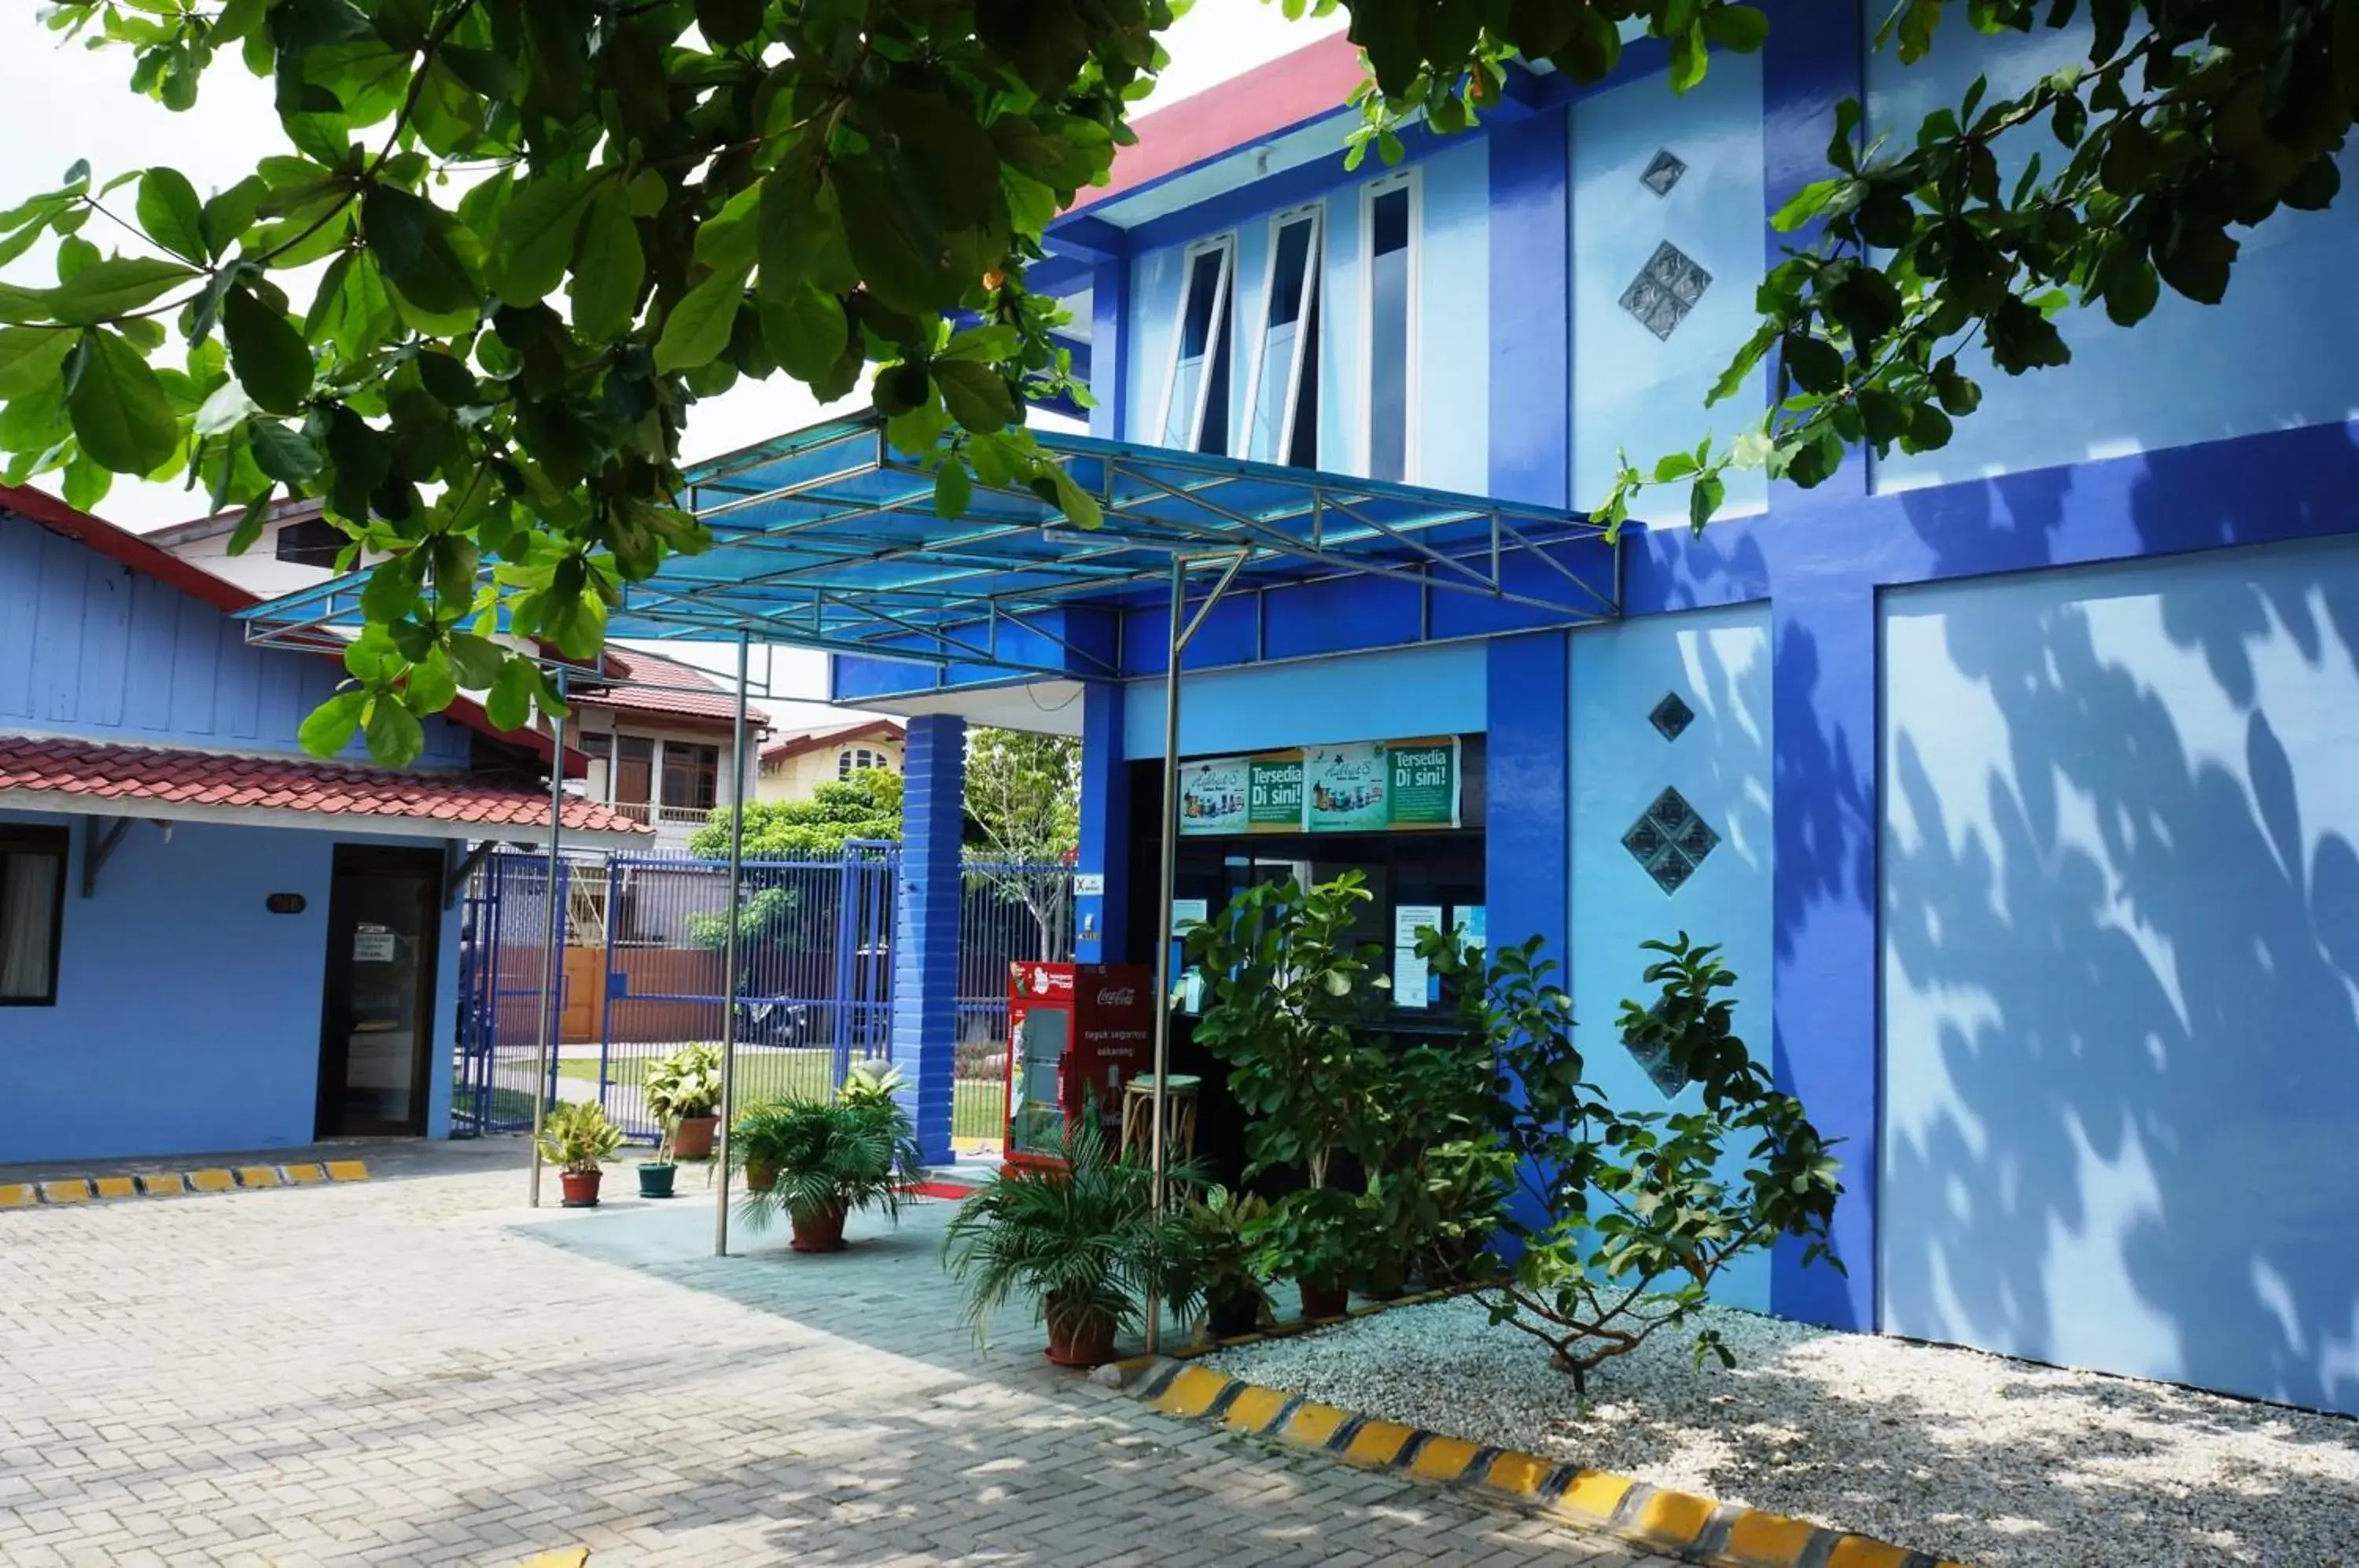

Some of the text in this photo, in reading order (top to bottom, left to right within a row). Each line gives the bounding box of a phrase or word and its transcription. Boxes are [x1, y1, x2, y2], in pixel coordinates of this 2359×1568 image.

[1395, 749, 1446, 767] Tersedia
[1253, 765, 1303, 784] Tersedia
[1396, 766, 1446, 786] Di sini!
[1253, 783, 1301, 804] Di sini!
